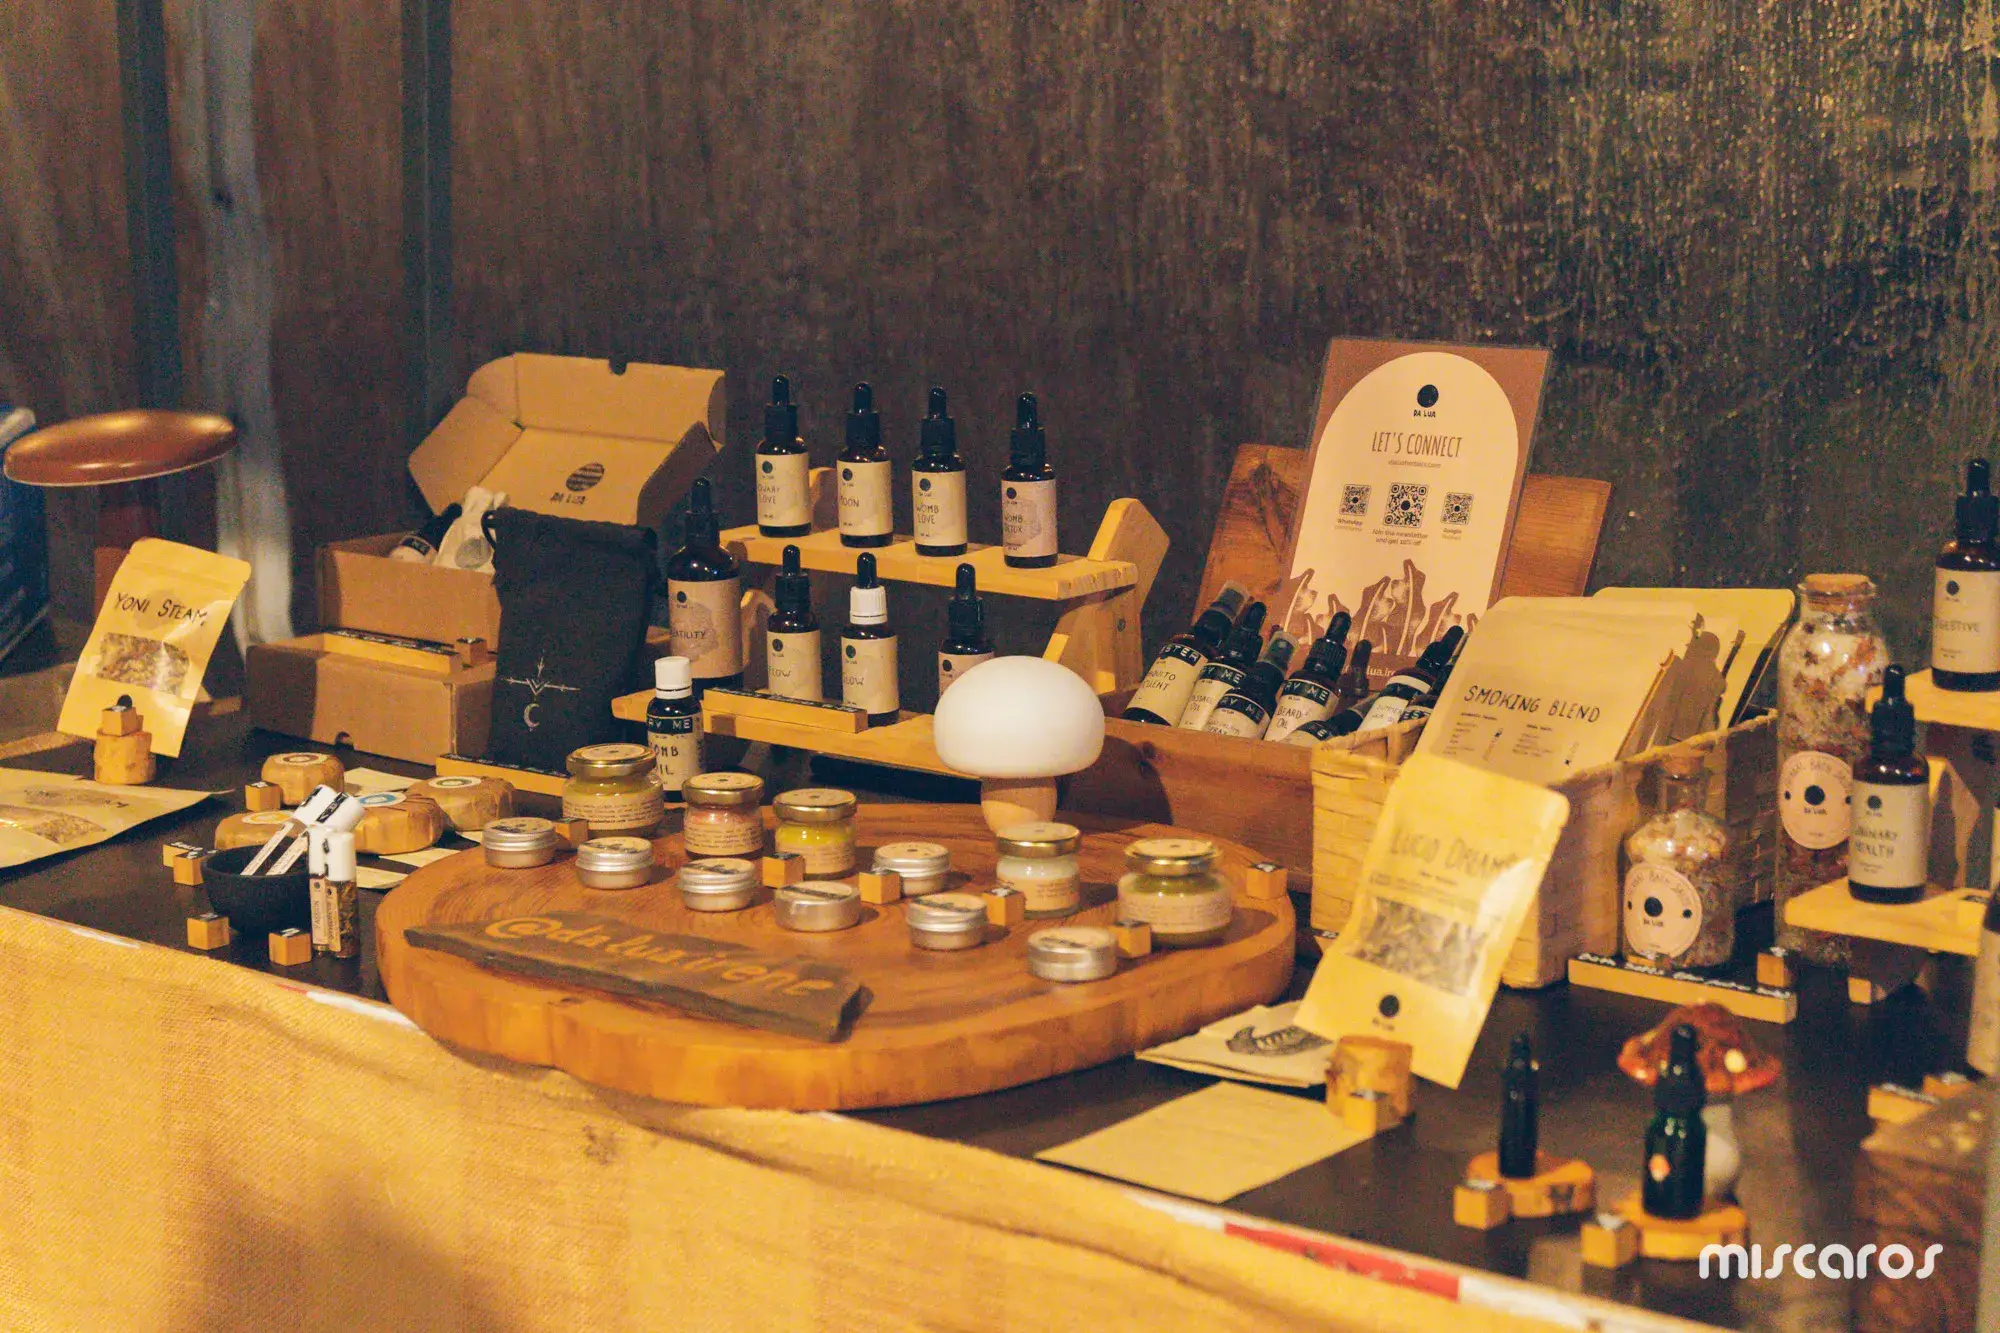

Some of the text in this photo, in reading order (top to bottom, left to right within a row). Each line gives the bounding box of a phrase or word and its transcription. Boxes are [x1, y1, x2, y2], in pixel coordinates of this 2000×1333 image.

[1413, 409, 1436, 418] DA LUA
[1372, 431, 1462, 458] LET'S CONNECT
[759, 494, 776, 504] LOVE
[916, 504, 939, 514] WOMB
[918, 514, 936, 524] LOVE
[114, 592, 150, 613] YONI
[158, 599, 208, 626] STEAM
[1221, 670, 1243, 684] ME
[1284, 682, 1329, 702] RY ME
[1219, 696, 1238, 706] RY
[1464, 684, 1601, 724] SMOKING BLEND
[1277, 706, 1302, 719] BEARD
[648, 718, 690, 730] RY ME
[1277, 718, 1288, 730] OIL
[650, 742, 679, 757] OMB
[660, 764, 674, 776] IL
